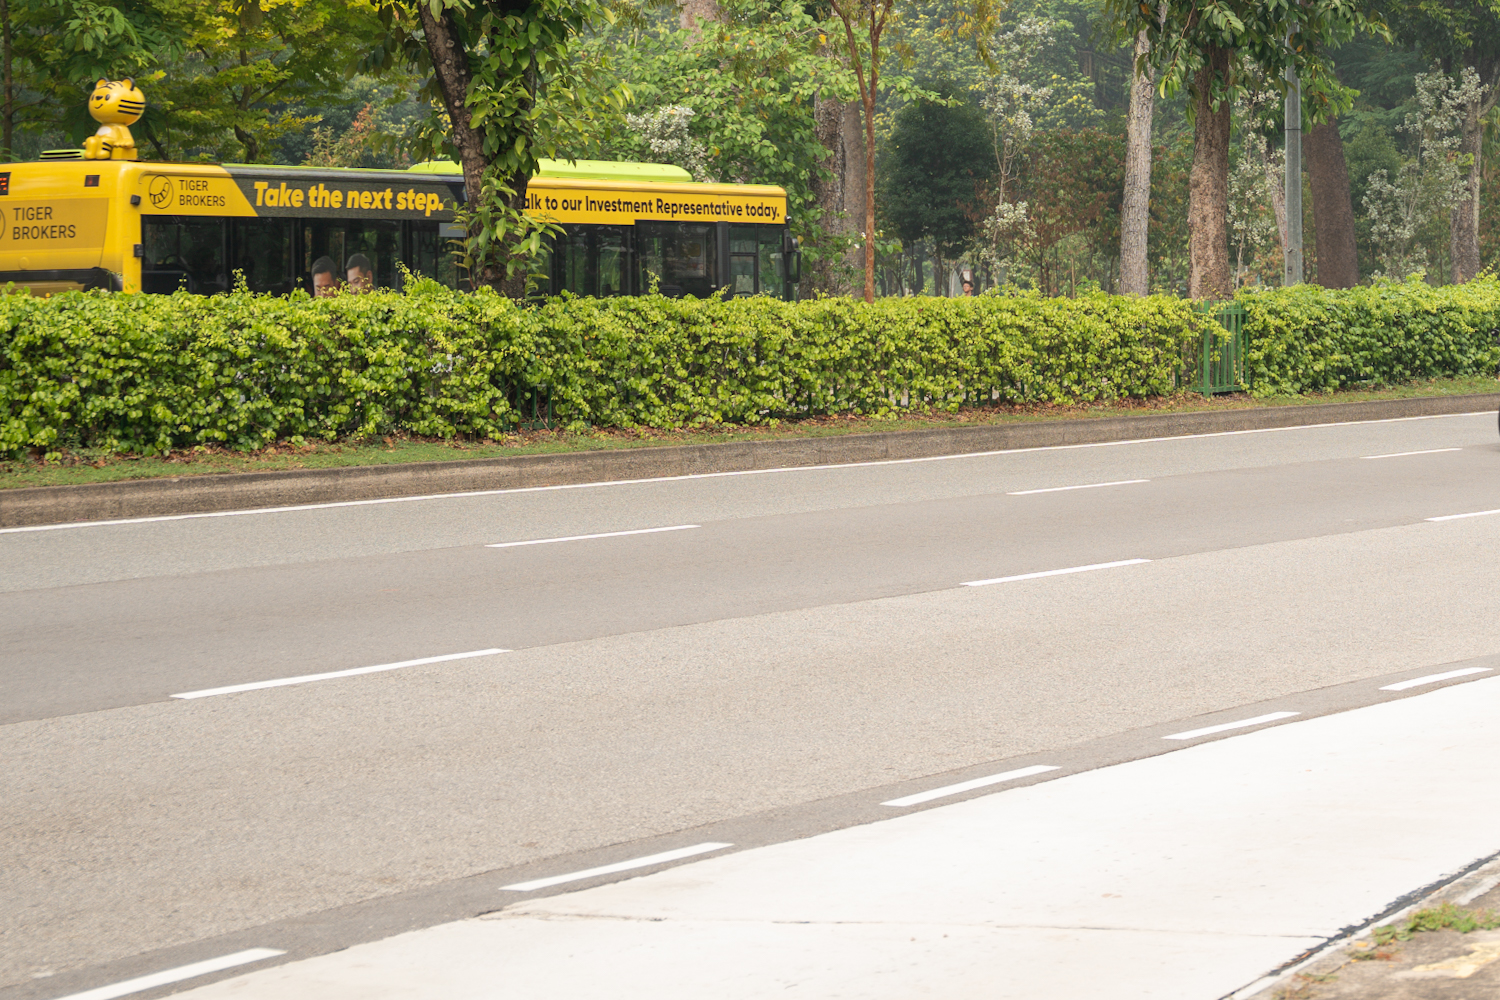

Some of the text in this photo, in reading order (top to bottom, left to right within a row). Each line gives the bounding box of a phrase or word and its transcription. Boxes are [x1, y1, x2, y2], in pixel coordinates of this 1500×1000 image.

[179, 179, 208, 191] TIGER
[179, 195, 226, 207] BROKERS
[254, 181, 444, 217] Take the next step.
[523, 193, 780, 220] alk to our Investment Representative today.
[12, 206, 53, 221] TIGER
[12, 224, 76, 240] BROKERS
